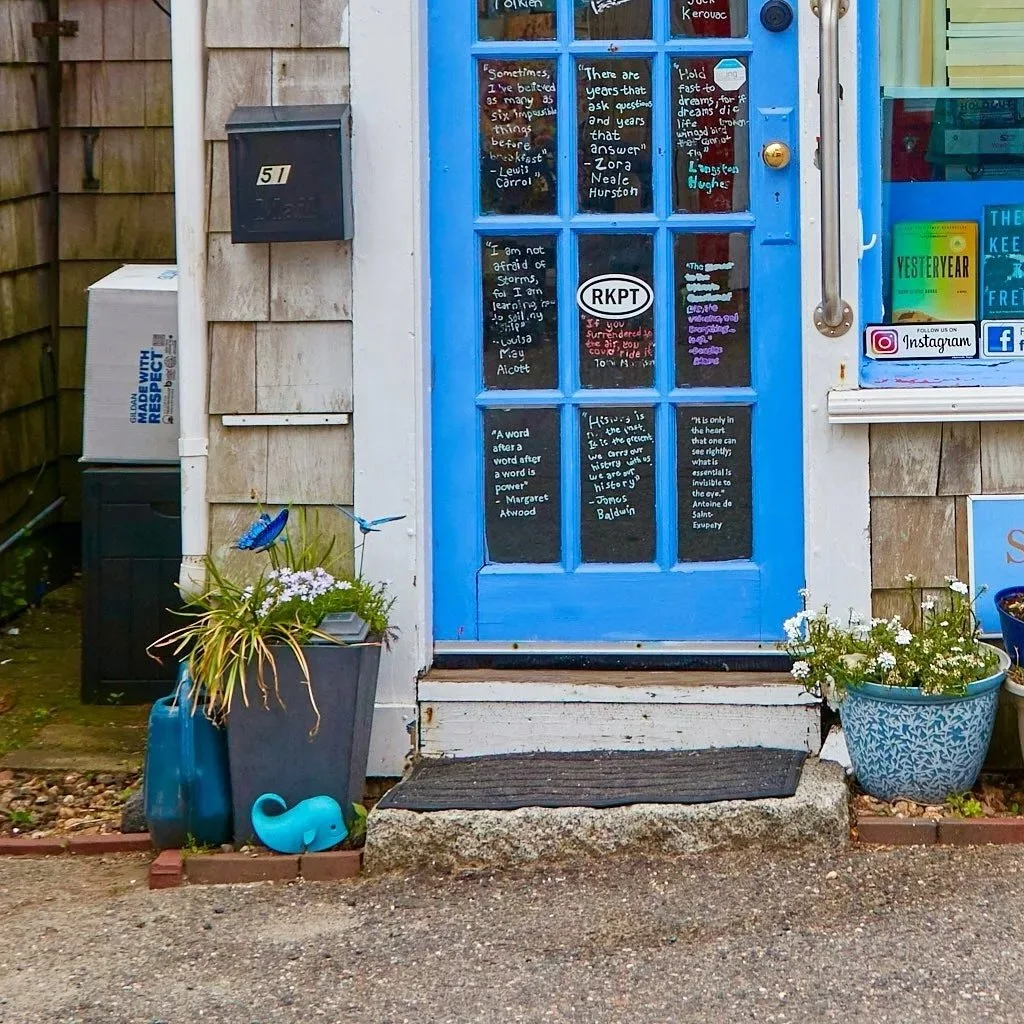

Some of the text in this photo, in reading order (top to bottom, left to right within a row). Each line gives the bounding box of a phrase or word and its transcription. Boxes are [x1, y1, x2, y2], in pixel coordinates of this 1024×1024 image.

[682, 6, 727, 20] Kerouac
[622, 71, 640, 80] are
[518, 82, 556, 93] believed
[586, 85, 646, 99] years that
[678, 84, 715, 93] fast to
[487, 95, 553, 108] as many as
[588, 100, 652, 113] ask questions
[491, 110, 510, 121] six
[678, 108, 713, 117] dreams
[589, 116, 645, 128] and years
[493, 124, 532, 137] things
[590, 129, 620, 141] that
[491, 138, 531, 150] before
[595, 158, 631, 171] Zora
[261, 168, 284, 183] 51
[500, 165, 528, 177] Lewis
[592, 173, 629, 185] Neale
[589, 187, 638, 198] Hurston
[991, 210, 1022, 226] THE
[527, 247, 545, 255] not
[493, 259, 546, 271] afraid of
[897, 256, 969, 279] YESTERYEAR
[592, 289, 639, 304] RKPT
[903, 334, 971, 353] Instagram
[138, 351, 149, 423] MADE WITH
[149, 351, 163, 424] RESPECT
[710, 416, 725, 425] only
[505, 428, 529, 439] word
[493, 443, 514, 452] after
[608, 449, 628, 457] carry
[494, 455, 541, 465] word after
[591, 458, 641, 472] history with
[502, 468, 535, 478] word is
[607, 471, 621, 479] are
[506, 494, 548, 505] Margaret
[500, 507, 536, 518] Atwood
[597, 505, 635, 520] Baldwin
